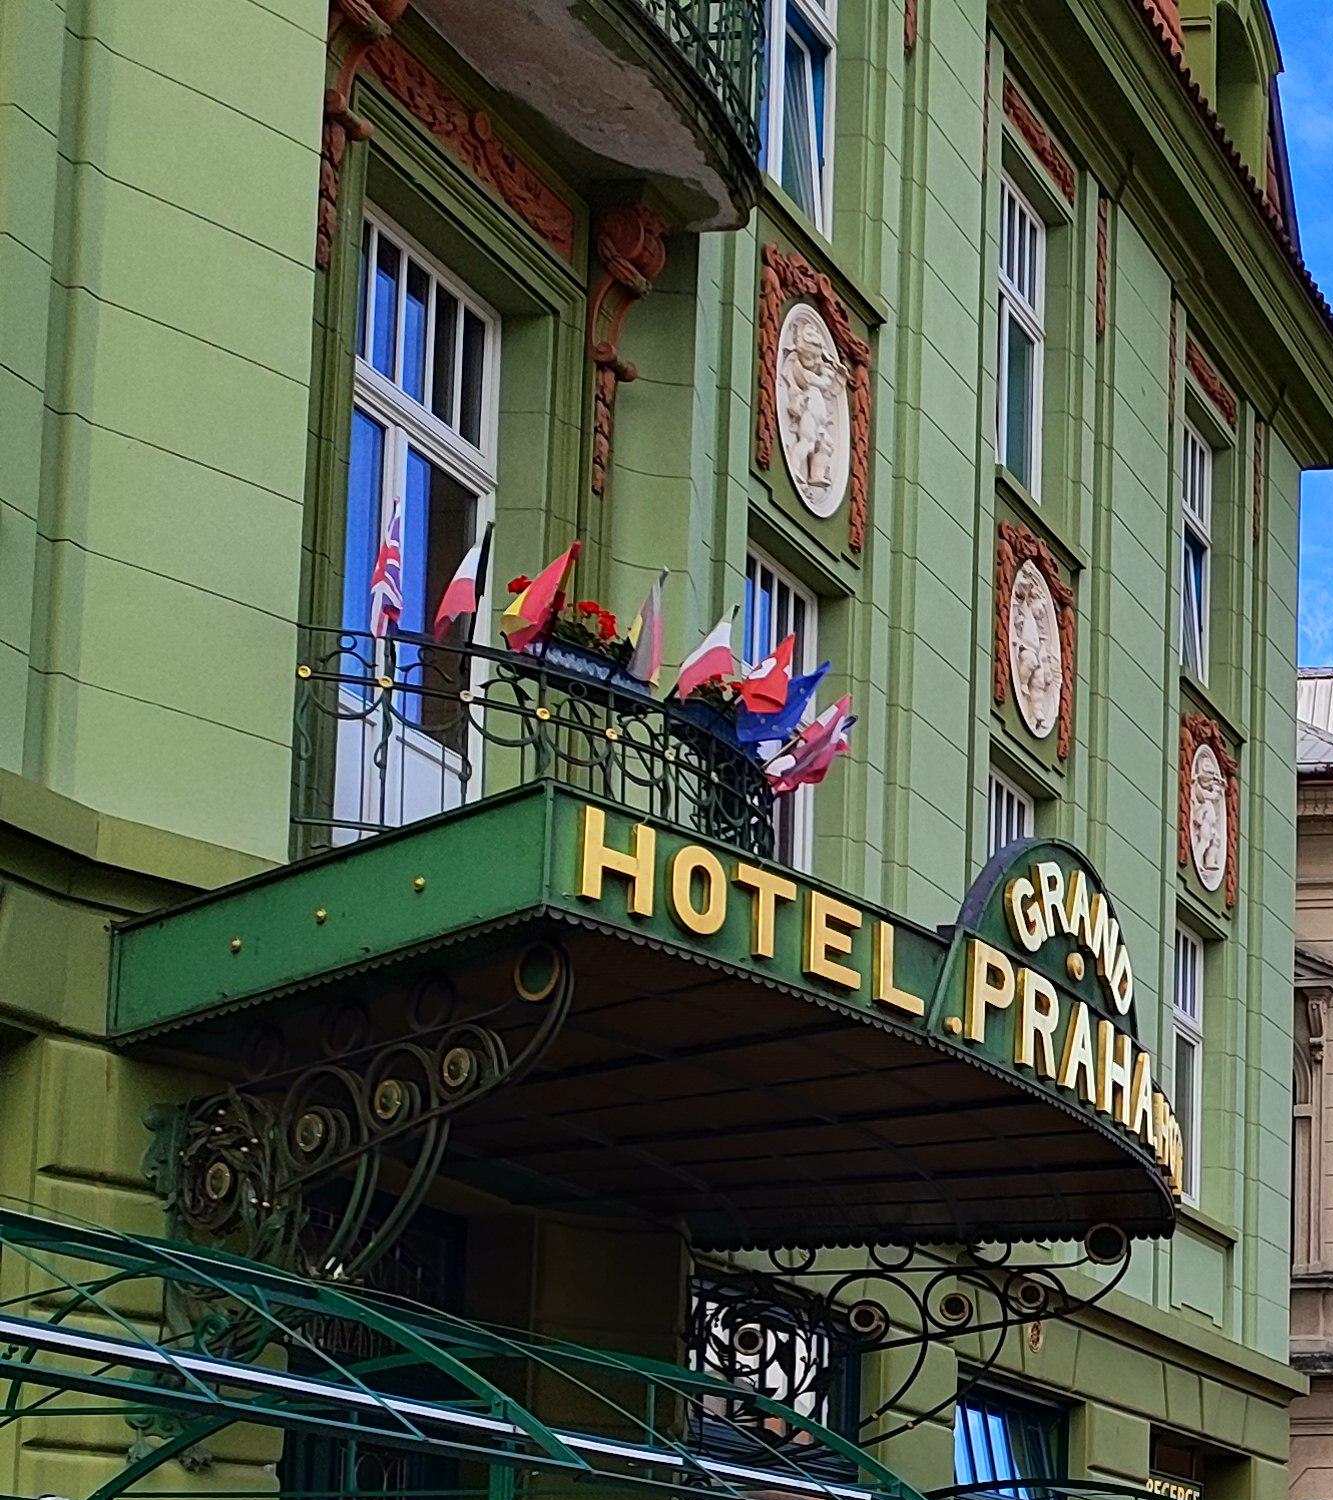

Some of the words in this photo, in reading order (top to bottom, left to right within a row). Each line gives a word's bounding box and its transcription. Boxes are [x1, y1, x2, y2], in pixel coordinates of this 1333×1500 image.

[579, 805, 925, 1017] HOTEL
[1005, 861, 1134, 1015] GRAND
[964, 938, 1156, 1147] PRAHA
